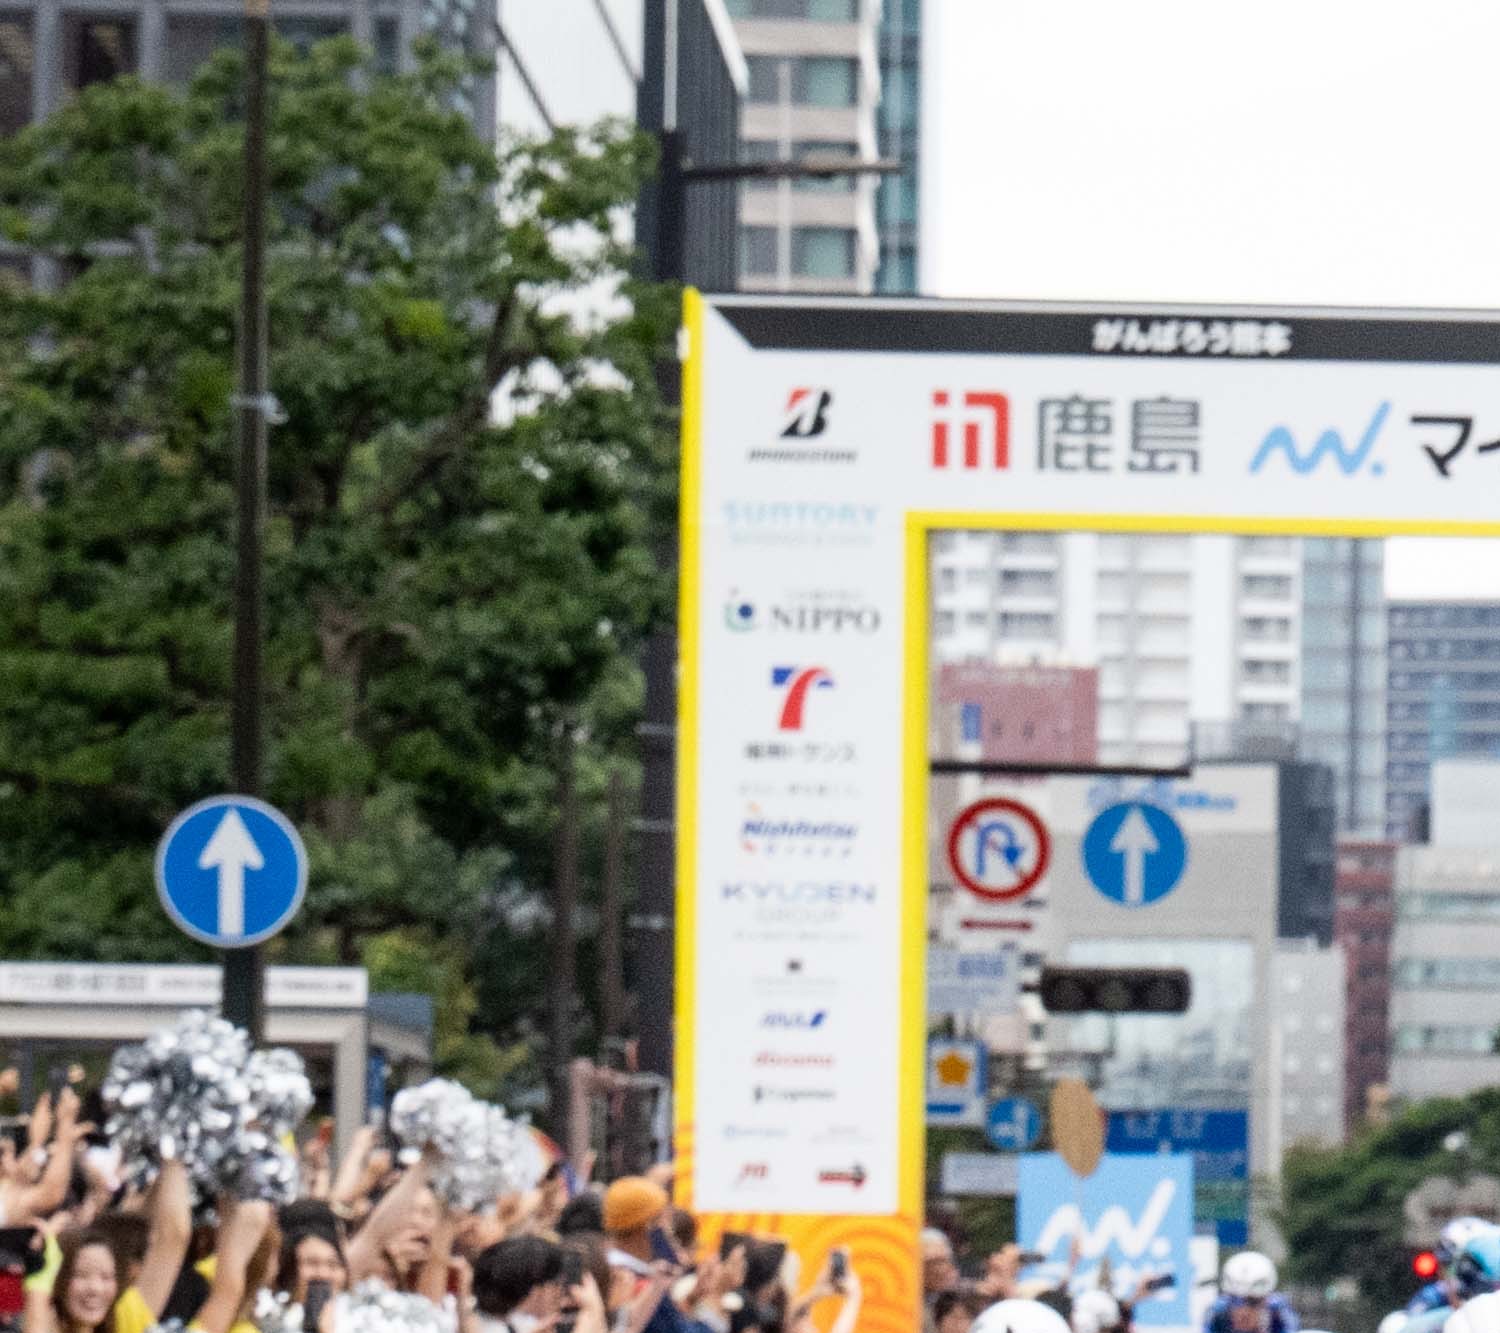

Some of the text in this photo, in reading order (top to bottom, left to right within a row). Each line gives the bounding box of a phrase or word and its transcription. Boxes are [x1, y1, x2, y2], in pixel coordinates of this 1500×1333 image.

[1036, 394, 1201, 473] 鹿島
[770, 603, 881, 633] NIPPO
[721, 880, 877, 902] KYUDEN
